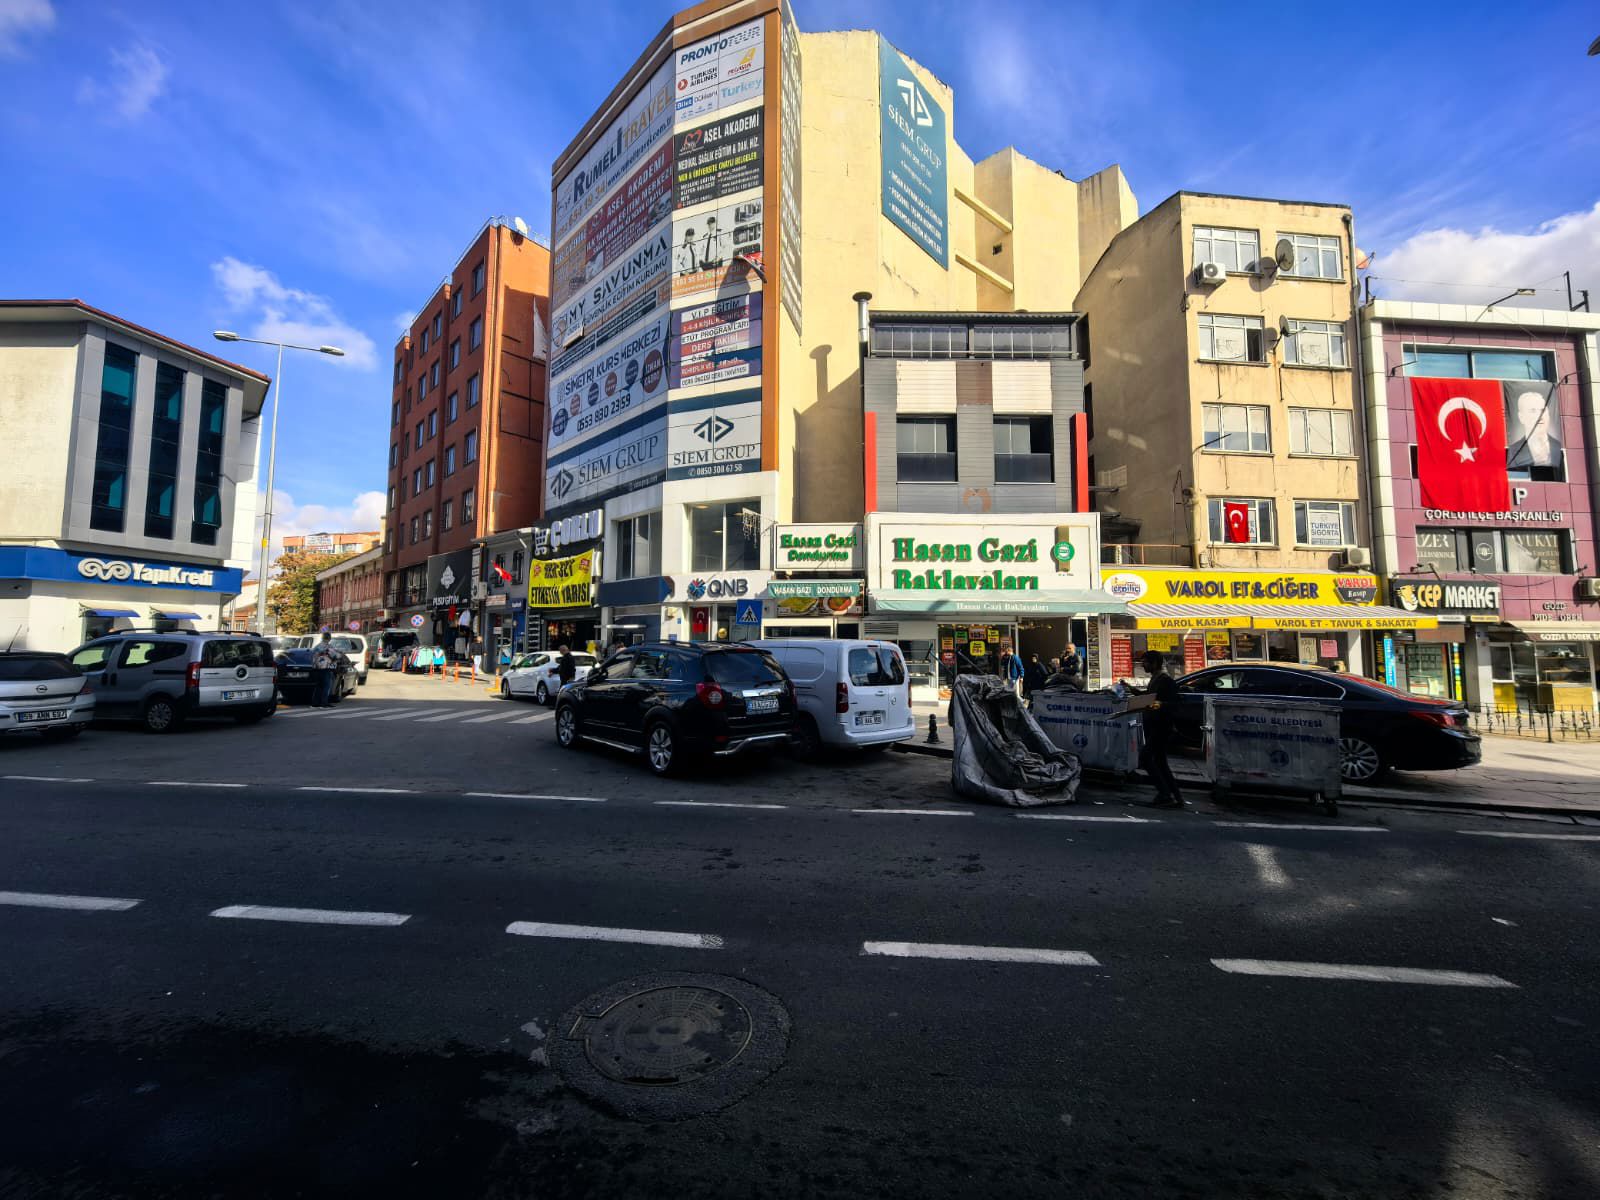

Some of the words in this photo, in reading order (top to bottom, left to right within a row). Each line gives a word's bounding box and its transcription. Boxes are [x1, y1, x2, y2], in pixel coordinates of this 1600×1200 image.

[690, 67, 718, 81] TURKISH
[690, 73, 718, 87] AIRLINES
[721, 79, 762, 98] Turkey
[704, 126, 722, 143] ASEL
[724, 111, 760, 138] AKADEMİ
[635, 256, 668, 286] KURUMU
[596, 352, 620, 377] KURS
[620, 321, 661, 360] MERKEZİ
[691, 342, 712, 352] DERS
[578, 454, 611, 485] SİEM
[615, 436, 658, 470] GRUP
[673, 450, 709, 466] SİEM
[714, 444, 756, 460] GRUP
[780, 534, 822, 548] Hasan
[825, 533, 858, 548] Gazi
[892, 537, 972, 562] Hasan
[978, 537, 1039, 562] Gazi
[1510, 534, 1558, 548] AVUKAT
[788, 549, 849, 561] Dondurma
[131, 562, 214, 586] YapıKredi
[892, 569, 1039, 590] Baklavaları
[1337, 577, 1376, 589] VAROL
[561, 582, 590, 604] YARISI
[709, 578, 748, 597] QNB
[774, 586, 795, 594] HASAN
[817, 585, 853, 594] DONDURMA
[1166, 580, 1227, 598] VAROL
[1417, 584, 1442, 608] CEP
[1445, 585, 1501, 609] MARKET
[956, 603, 981, 611] Hasan
[1005, 603, 1049, 612] Baklavaları
[1160, 619, 1194, 628] VAROL
[1196, 618, 1230, 627] KASAP
[1274, 619, 1308, 628] VAROL
[1310, 619, 1322, 628] ET
[1330, 619, 1363, 628] TAVUK
[1366, 619, 1373, 628] &
[1375, 618, 1418, 628] SAKATAT
